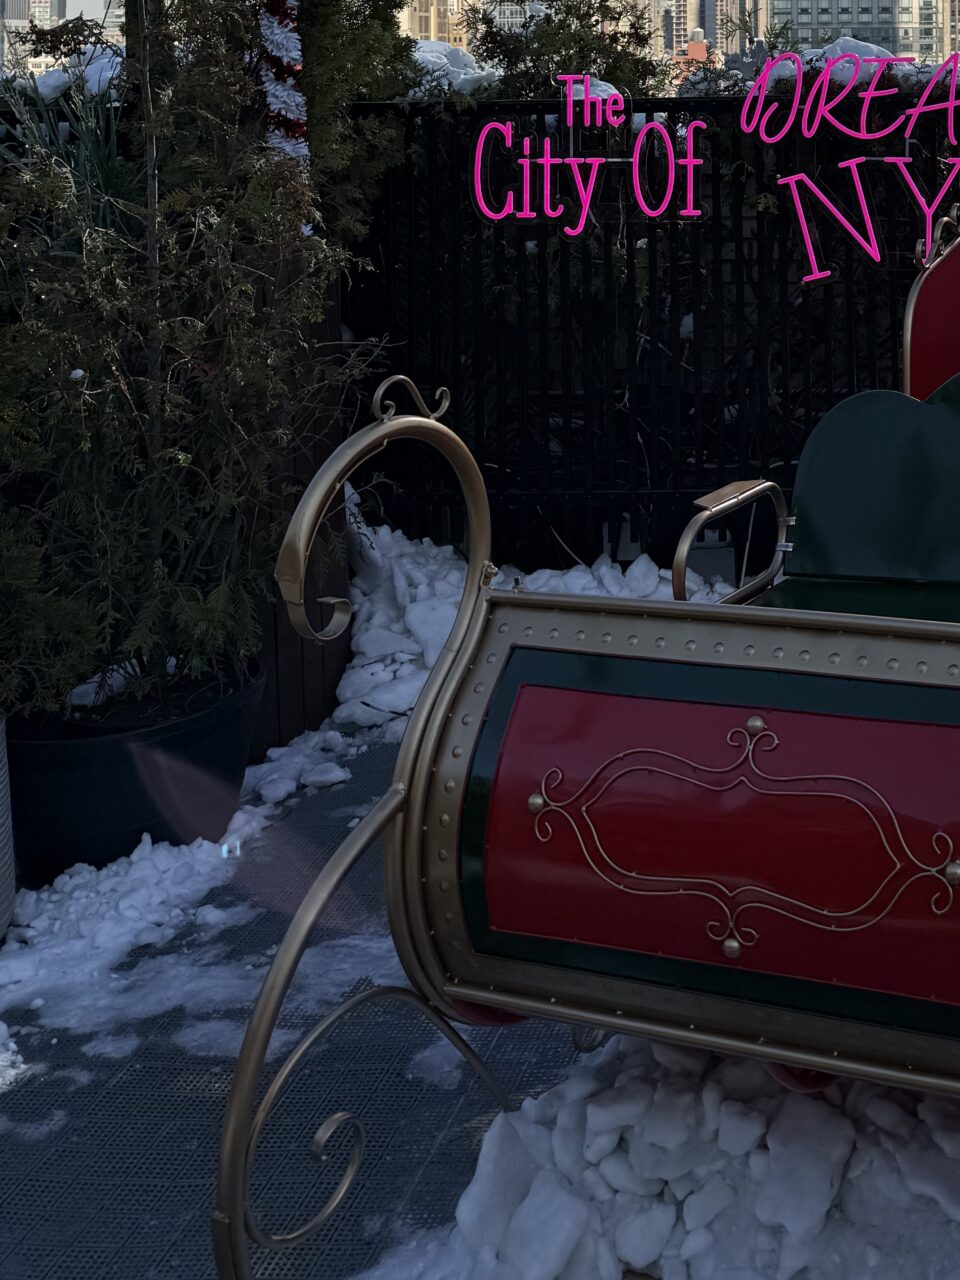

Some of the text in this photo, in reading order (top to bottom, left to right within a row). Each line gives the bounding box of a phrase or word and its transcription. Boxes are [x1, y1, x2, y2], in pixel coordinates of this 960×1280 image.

[556, 74, 626, 128] The
[474, 120, 708, 236] City Of
